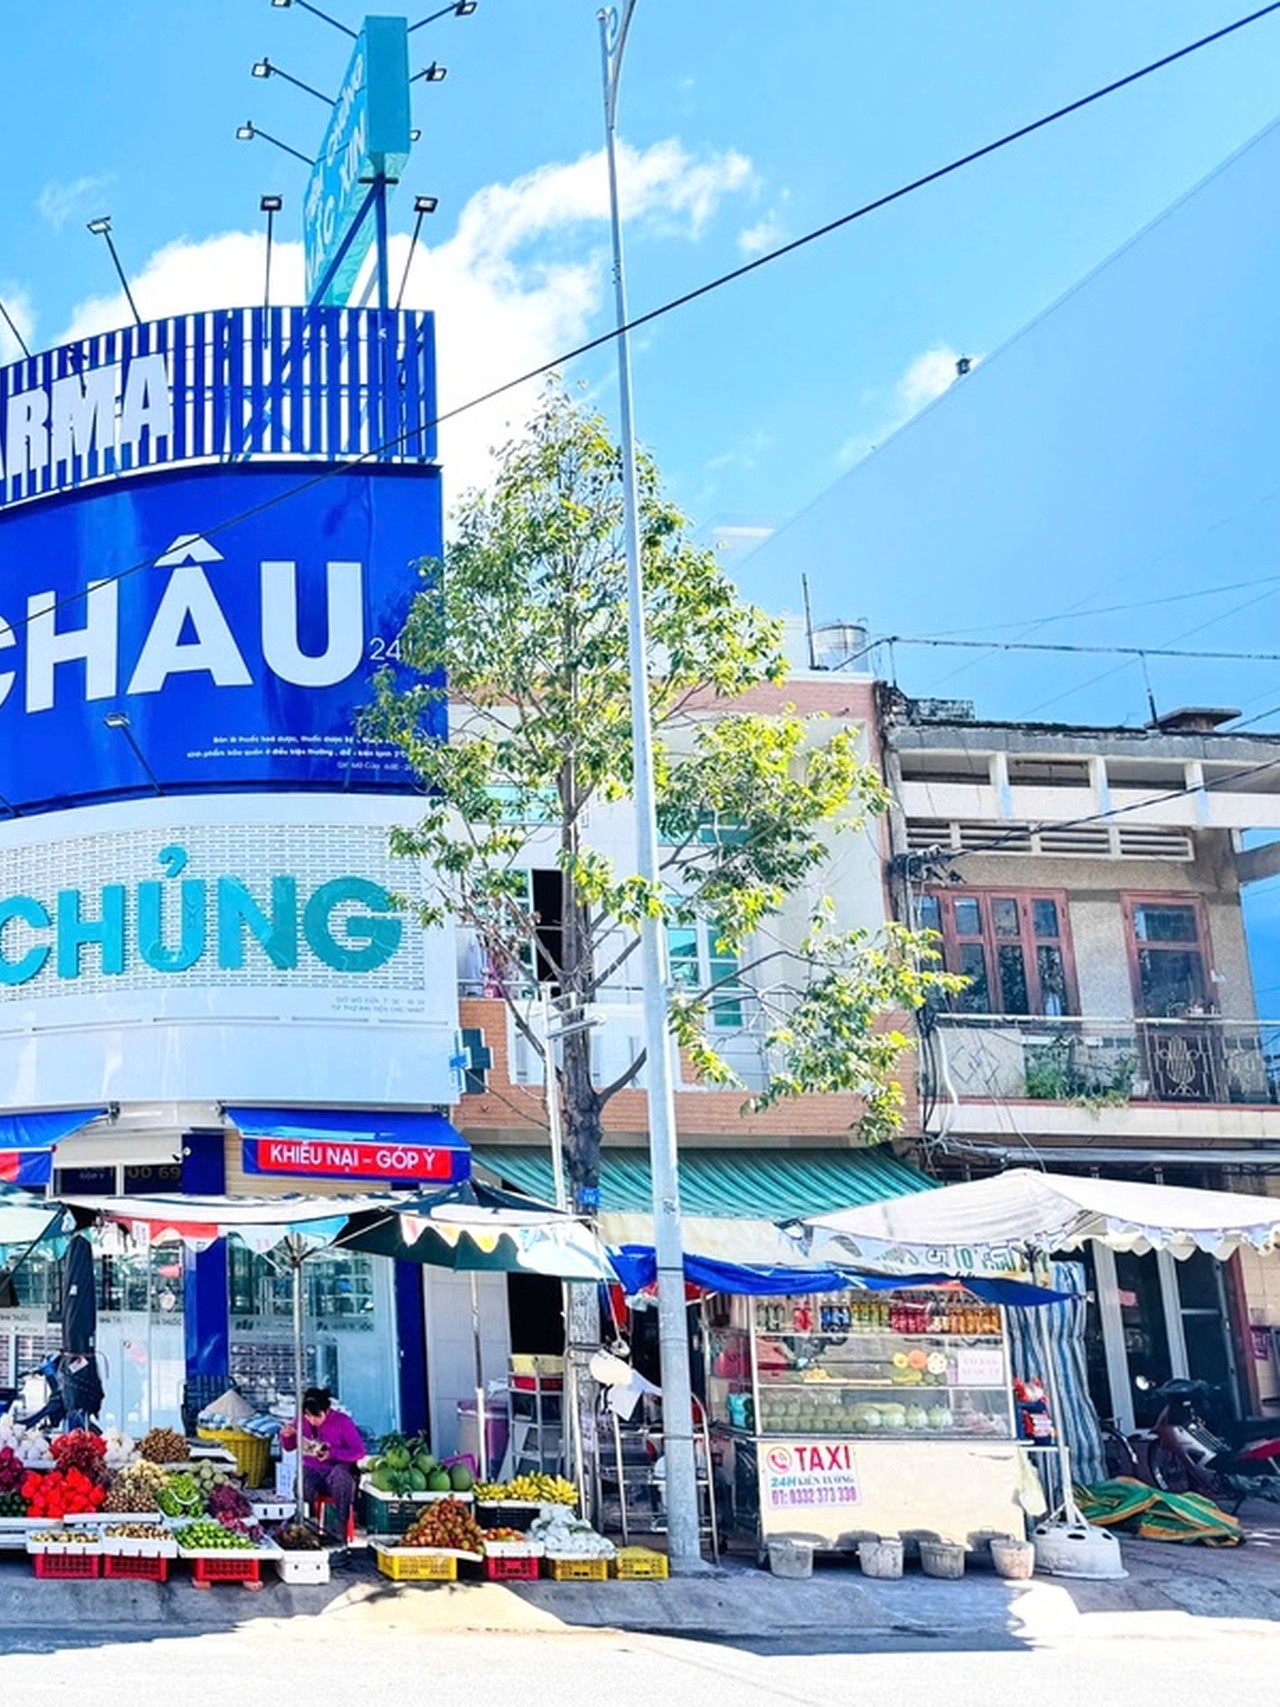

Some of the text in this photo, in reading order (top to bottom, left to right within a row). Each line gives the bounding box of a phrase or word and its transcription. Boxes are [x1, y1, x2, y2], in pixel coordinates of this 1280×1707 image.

[270, 1140, 322, 1165] KHIẾU
[327, 1147, 359, 1173] NẠI
[376, 1146, 419, 1169] GÓP
[423, 1148, 435, 1171] Ý
[793, 1444, 852, 1472] TAXI
